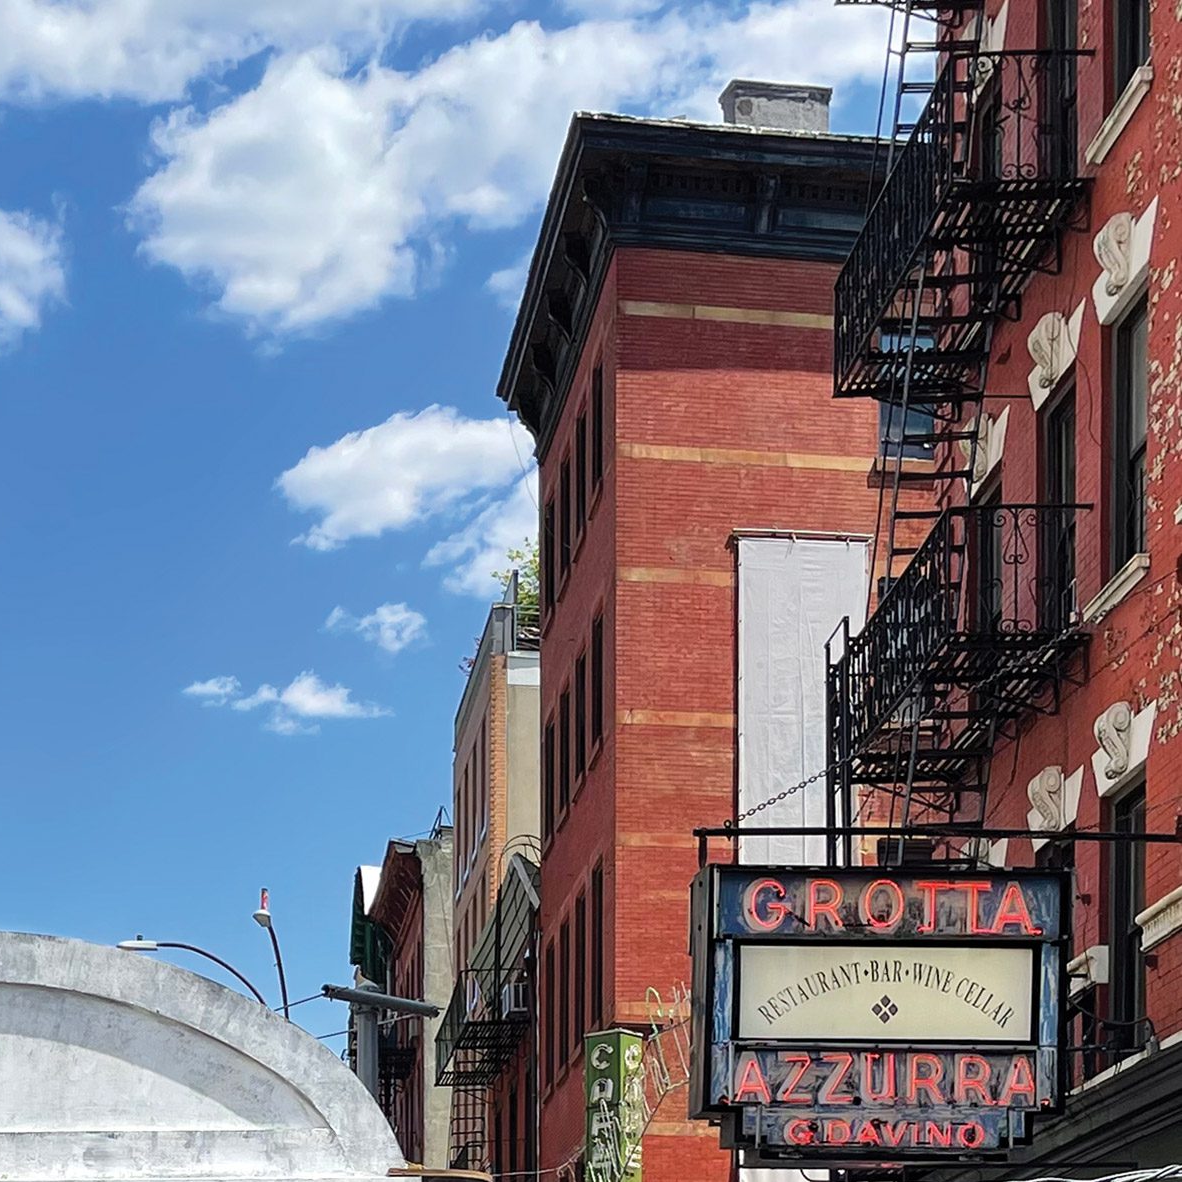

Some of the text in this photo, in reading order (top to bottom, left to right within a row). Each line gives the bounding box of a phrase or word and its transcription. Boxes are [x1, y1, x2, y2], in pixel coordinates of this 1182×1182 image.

[742, 876, 1044, 936] GROTTA
[756, 959, 1017, 1029] RESTAURANT BAR WINE CELLAR
[734, 1051, 1036, 1106] AZZURRA
